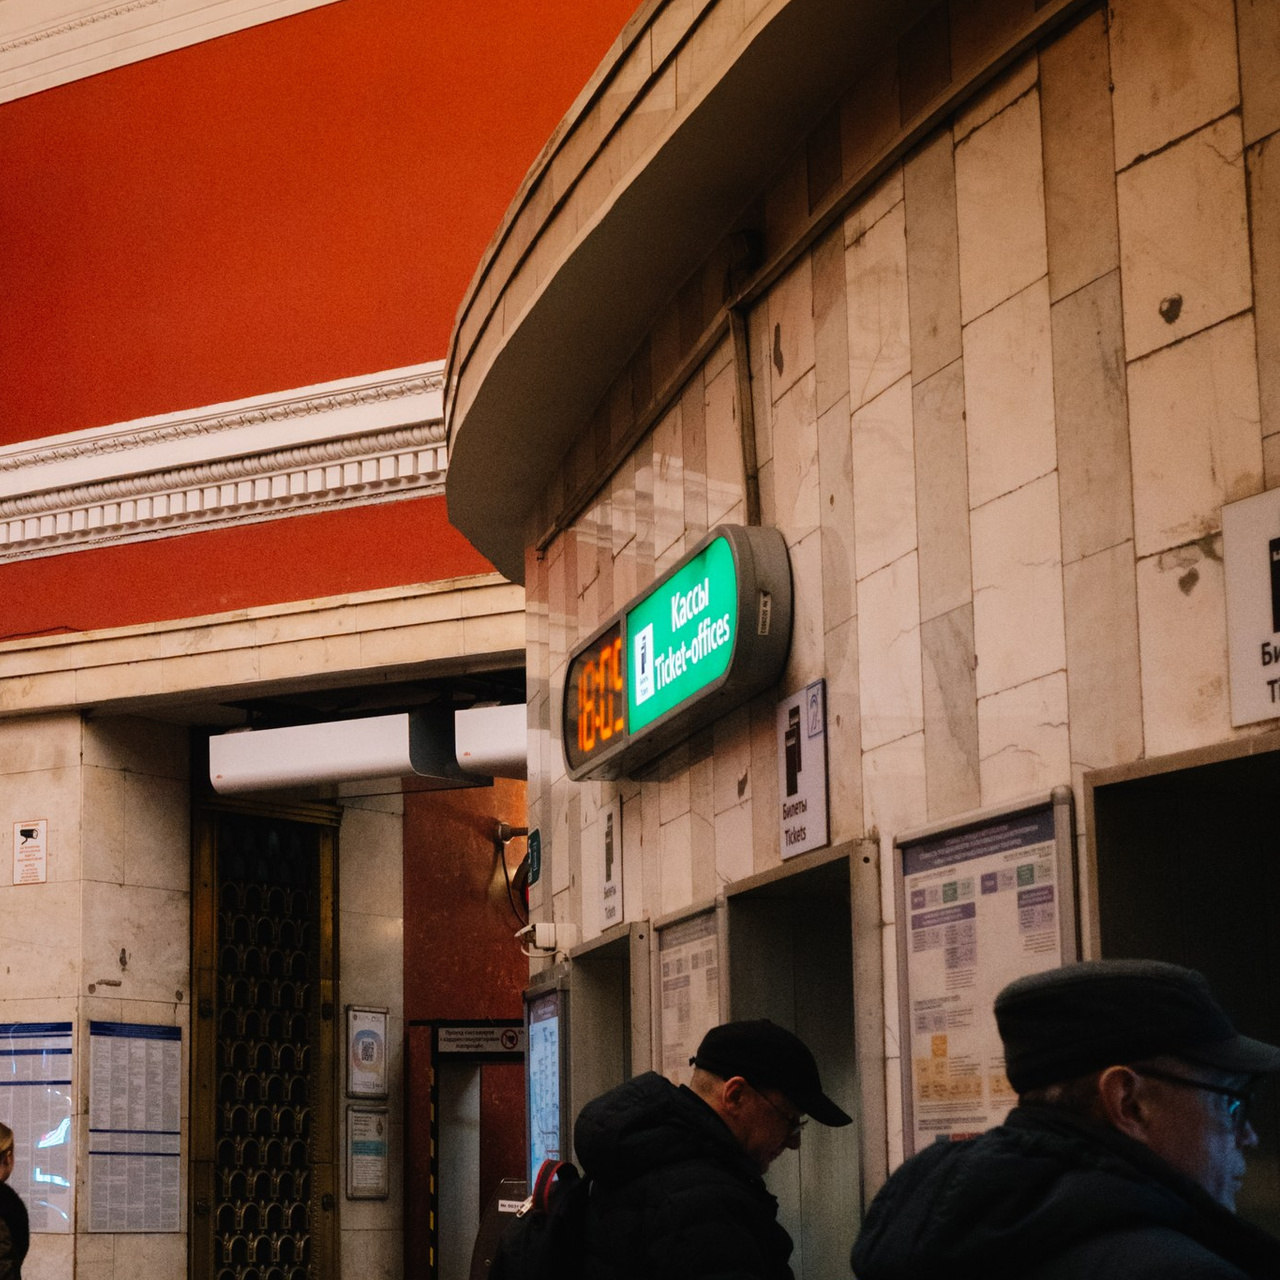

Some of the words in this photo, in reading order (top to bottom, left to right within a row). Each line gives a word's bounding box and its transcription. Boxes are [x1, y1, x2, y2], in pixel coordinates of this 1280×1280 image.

[671, 577, 710, 633] Кассы
[655, 613, 730, 691] Ticket-offices
[782, 799, 808, 820] Билеты
[784, 826, 807, 847] Tickets
